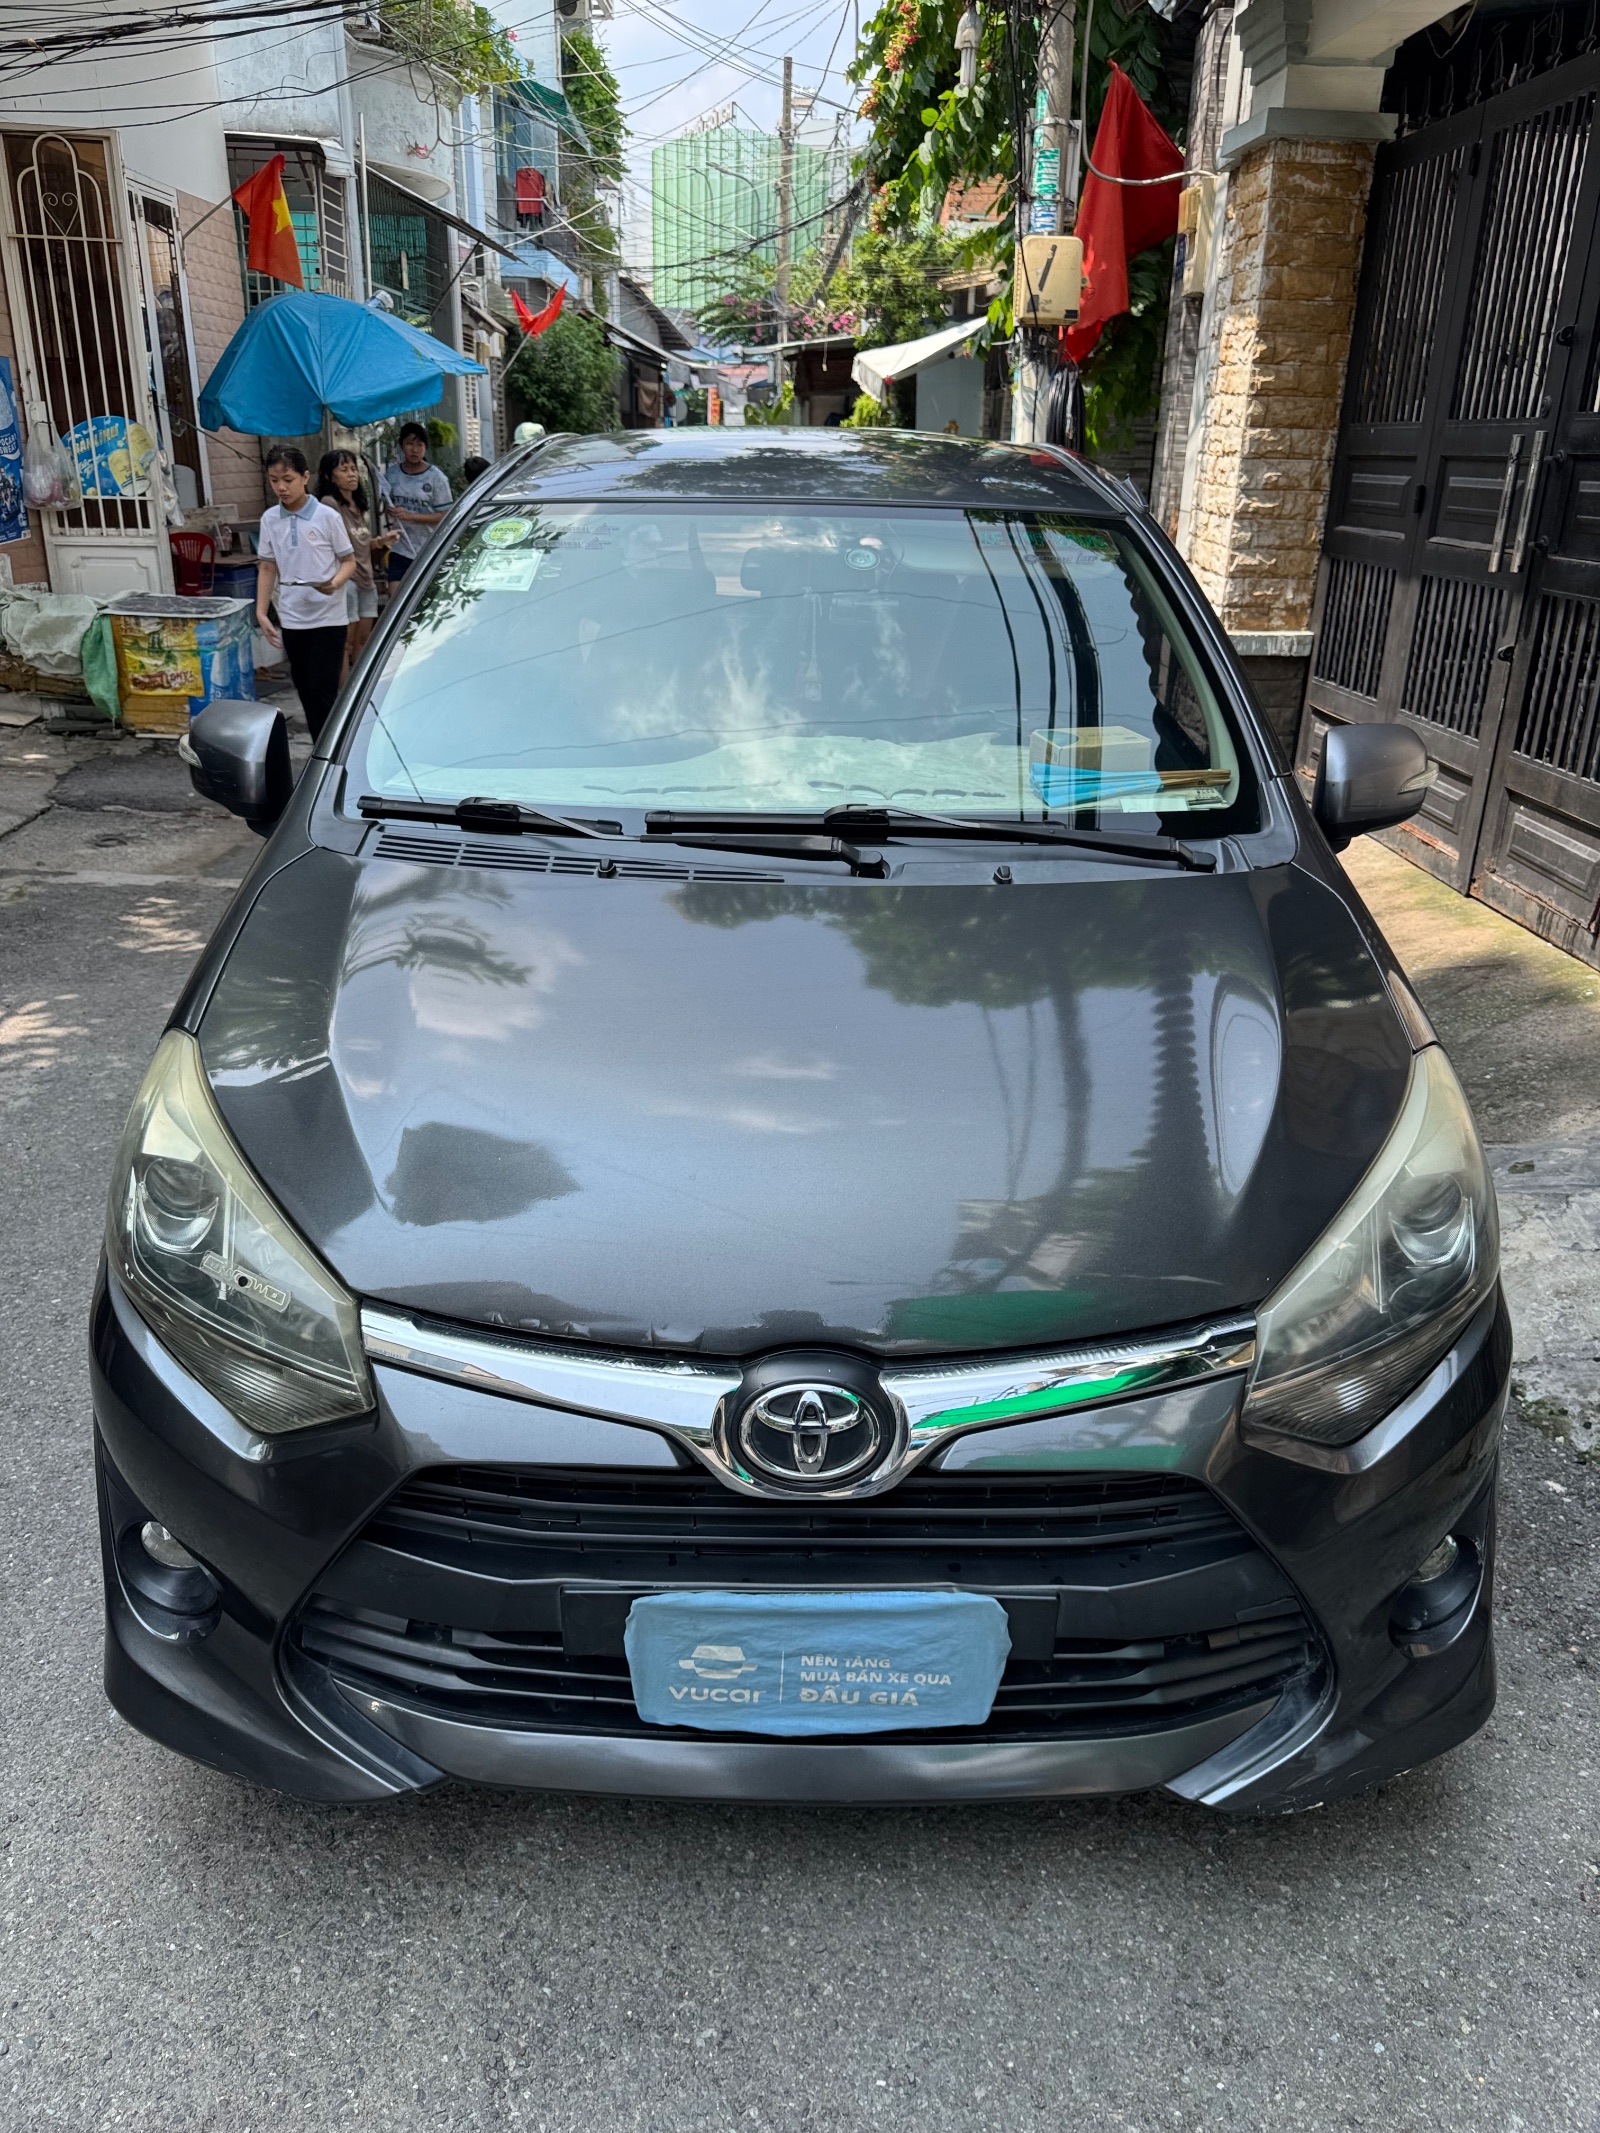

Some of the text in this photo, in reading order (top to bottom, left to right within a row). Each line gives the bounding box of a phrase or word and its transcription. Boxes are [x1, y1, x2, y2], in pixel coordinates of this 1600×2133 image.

[0, 433, 17, 447] OCARI
[844, 1657, 891, 1669] TẢNG
[800, 1669, 952, 1686] MUA BÁN XE QUA
[668, 1685, 767, 1705] vucar
[800, 1684, 919, 1707] ĐẤU GIÁ
